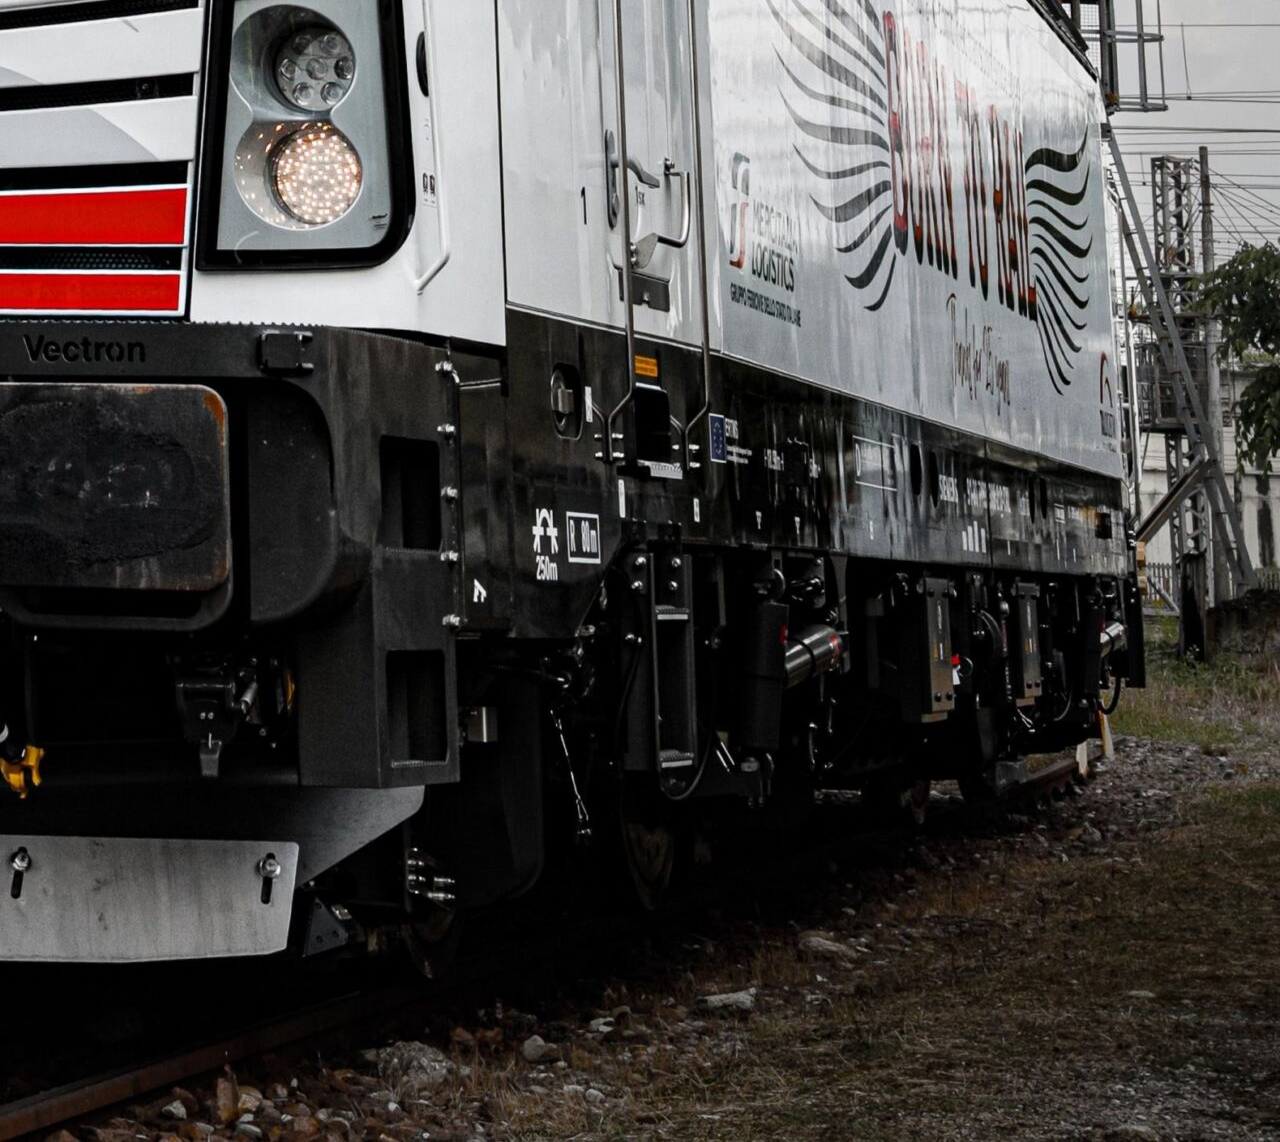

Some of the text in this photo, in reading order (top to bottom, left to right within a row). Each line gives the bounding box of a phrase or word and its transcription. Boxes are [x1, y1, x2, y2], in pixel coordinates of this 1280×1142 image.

[751, 241, 795, 292] LOGISTICS
[23, 333, 148, 363] Vectron
[569, 519, 598, 553] R 80m
[536, 555, 558, 581] 250m
